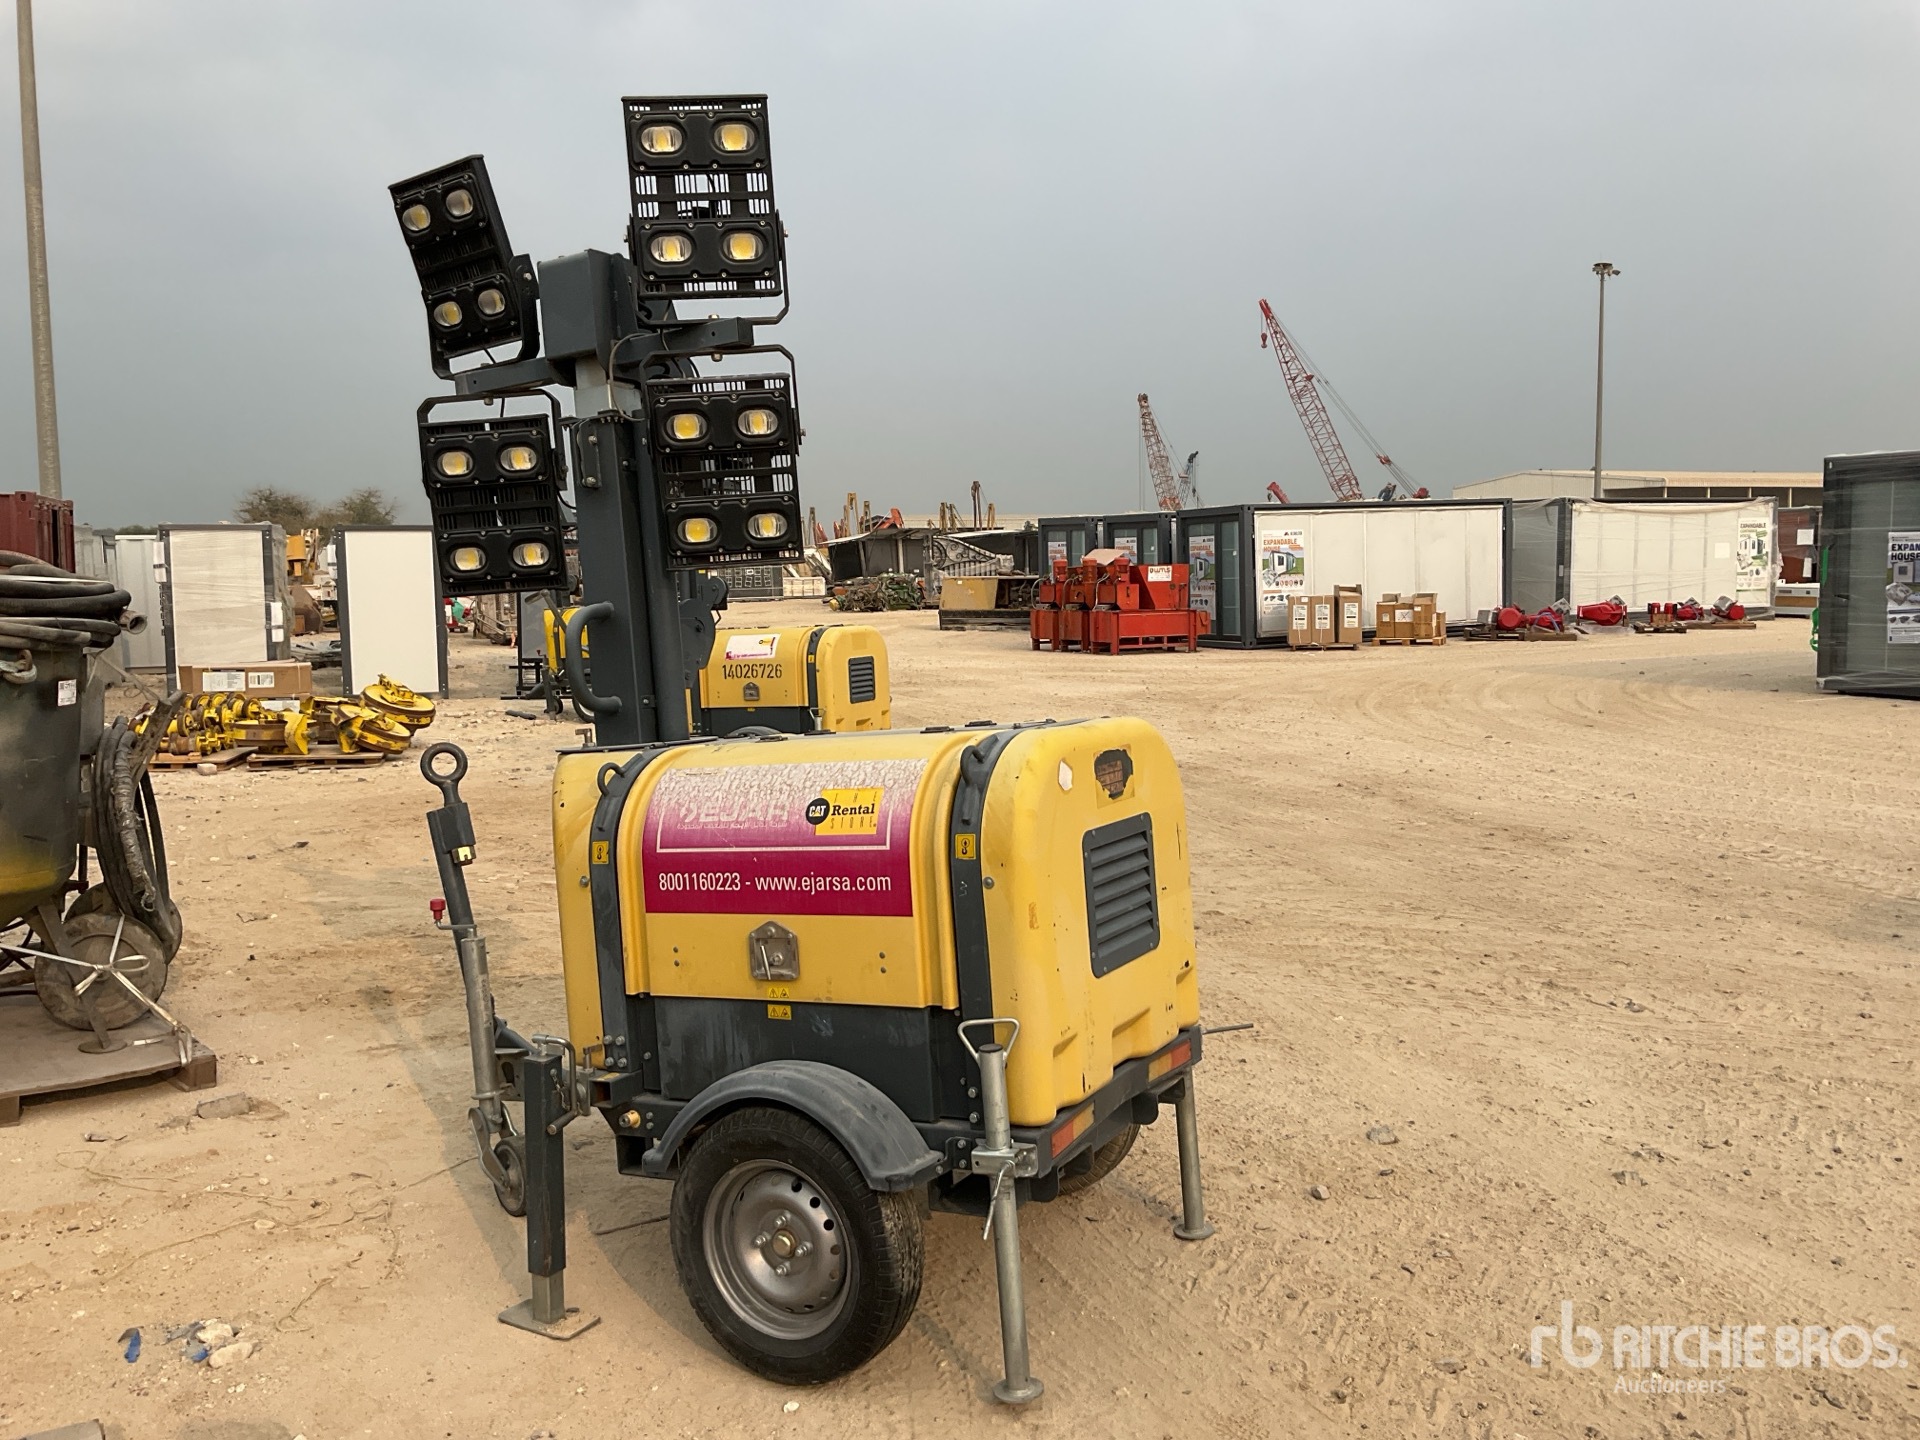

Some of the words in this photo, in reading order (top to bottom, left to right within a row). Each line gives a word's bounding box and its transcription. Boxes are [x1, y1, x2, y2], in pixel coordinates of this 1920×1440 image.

[1891, 552, 1920, 560] HOUSE
[722, 663, 782, 679] 14026726
[809, 805, 826, 817] CAT
[831, 803, 875, 816] Rental
[659, 872, 741, 891] 8001160223
[754, 871, 891, 895] www.ejarsa.com
